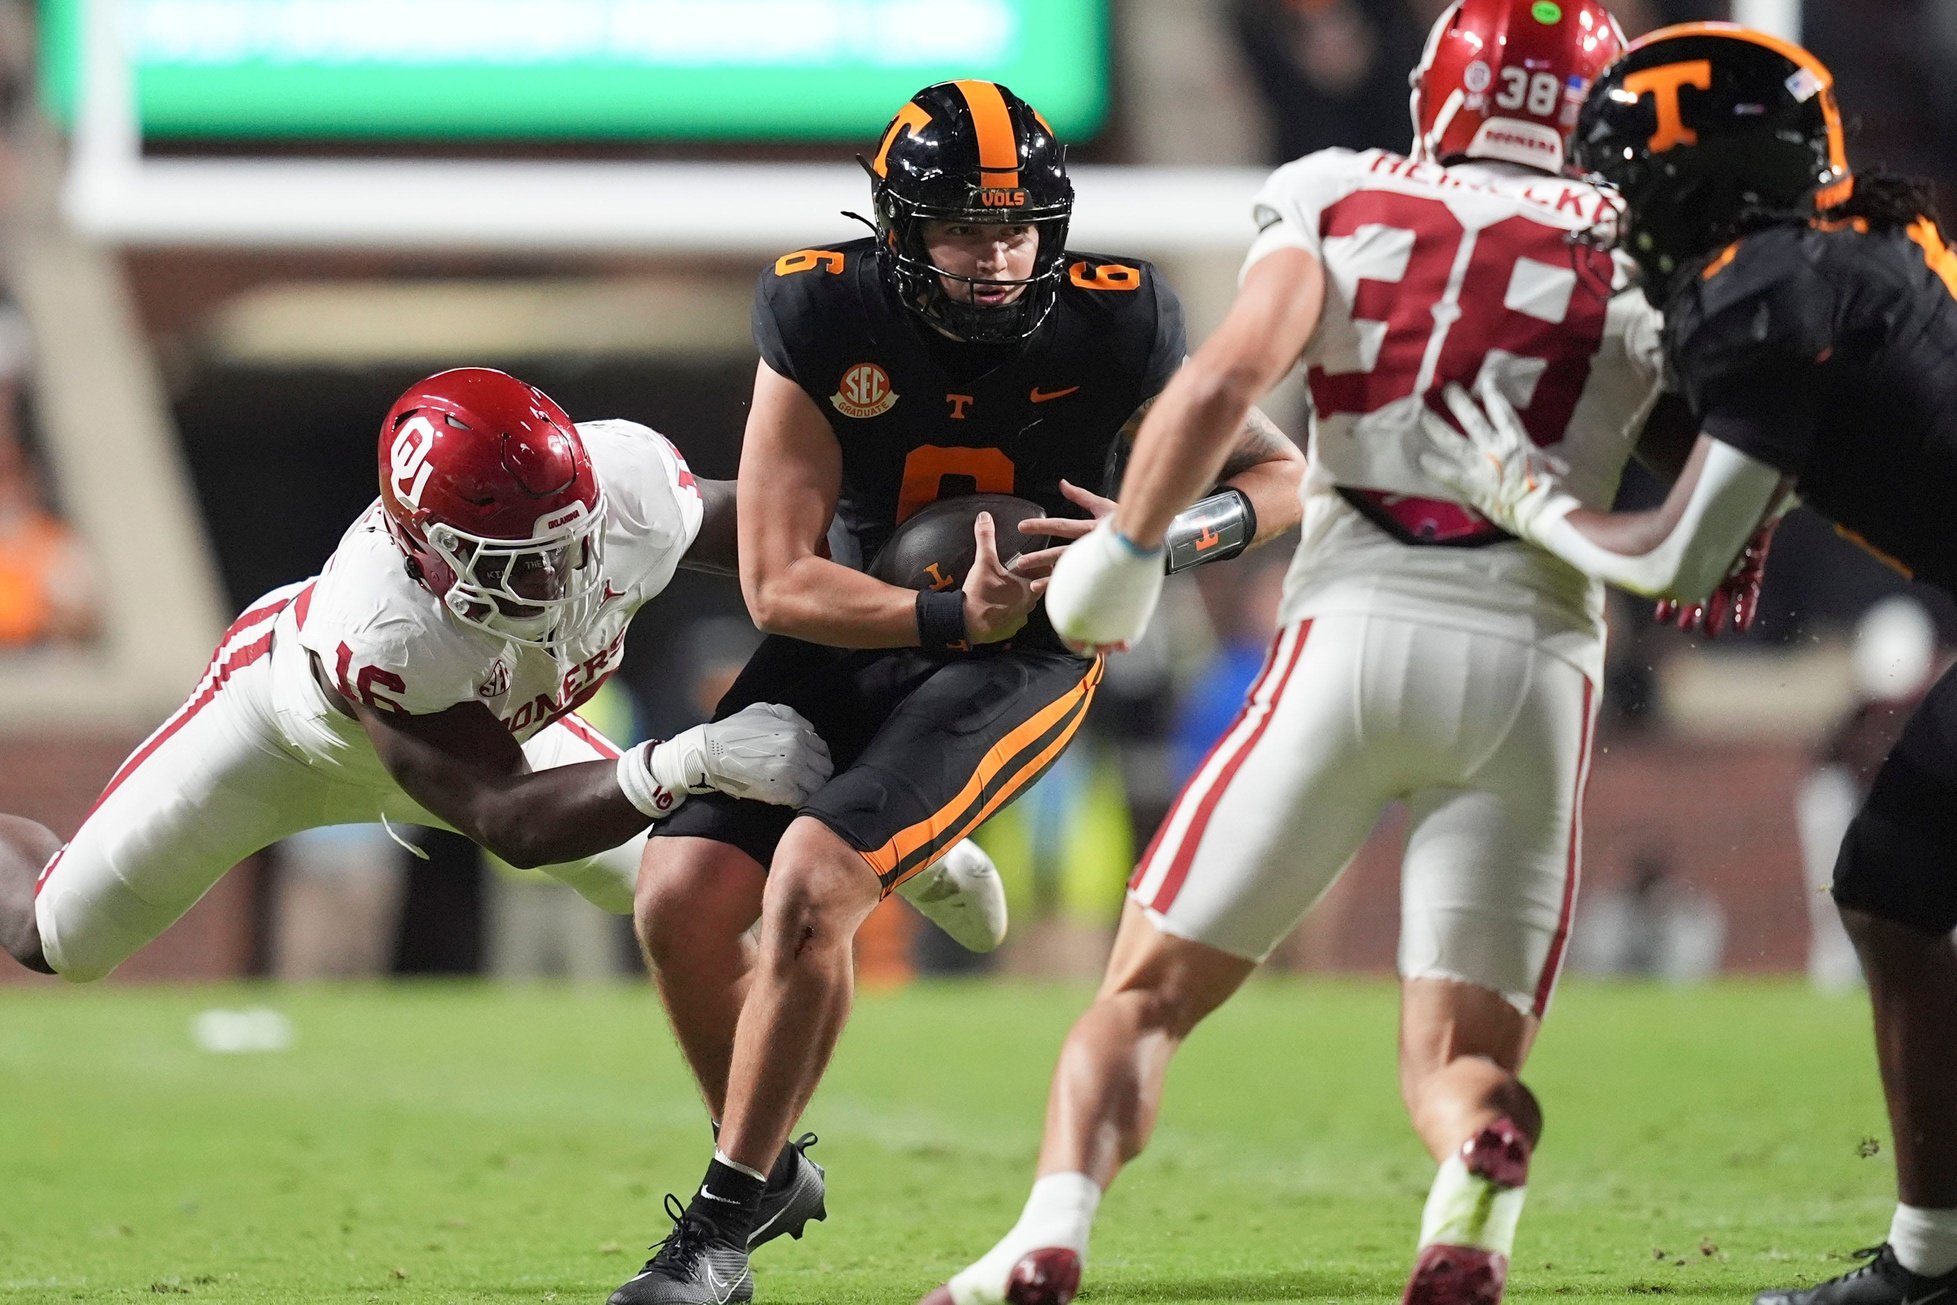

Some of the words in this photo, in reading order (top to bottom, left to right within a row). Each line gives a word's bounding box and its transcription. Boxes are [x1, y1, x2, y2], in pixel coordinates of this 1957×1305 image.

[1496, 65, 1559, 116] 38
[1623, 59, 1711, 153] T
[981, 191, 1025, 207] VOLS
[775, 248, 845, 276] 6
[1068, 261, 1141, 291] 6
[1304, 189, 1613, 448] 38
[845, 366, 885, 405] SEC
[838, 400, 890, 417] GRADUATE
[946, 394, 974, 419] T
[391, 416, 434, 507] OU
[548, 509, 580, 530] OKLAHOMA
[336, 640, 408, 715] 16
[501, 625, 626, 733] ONERS
